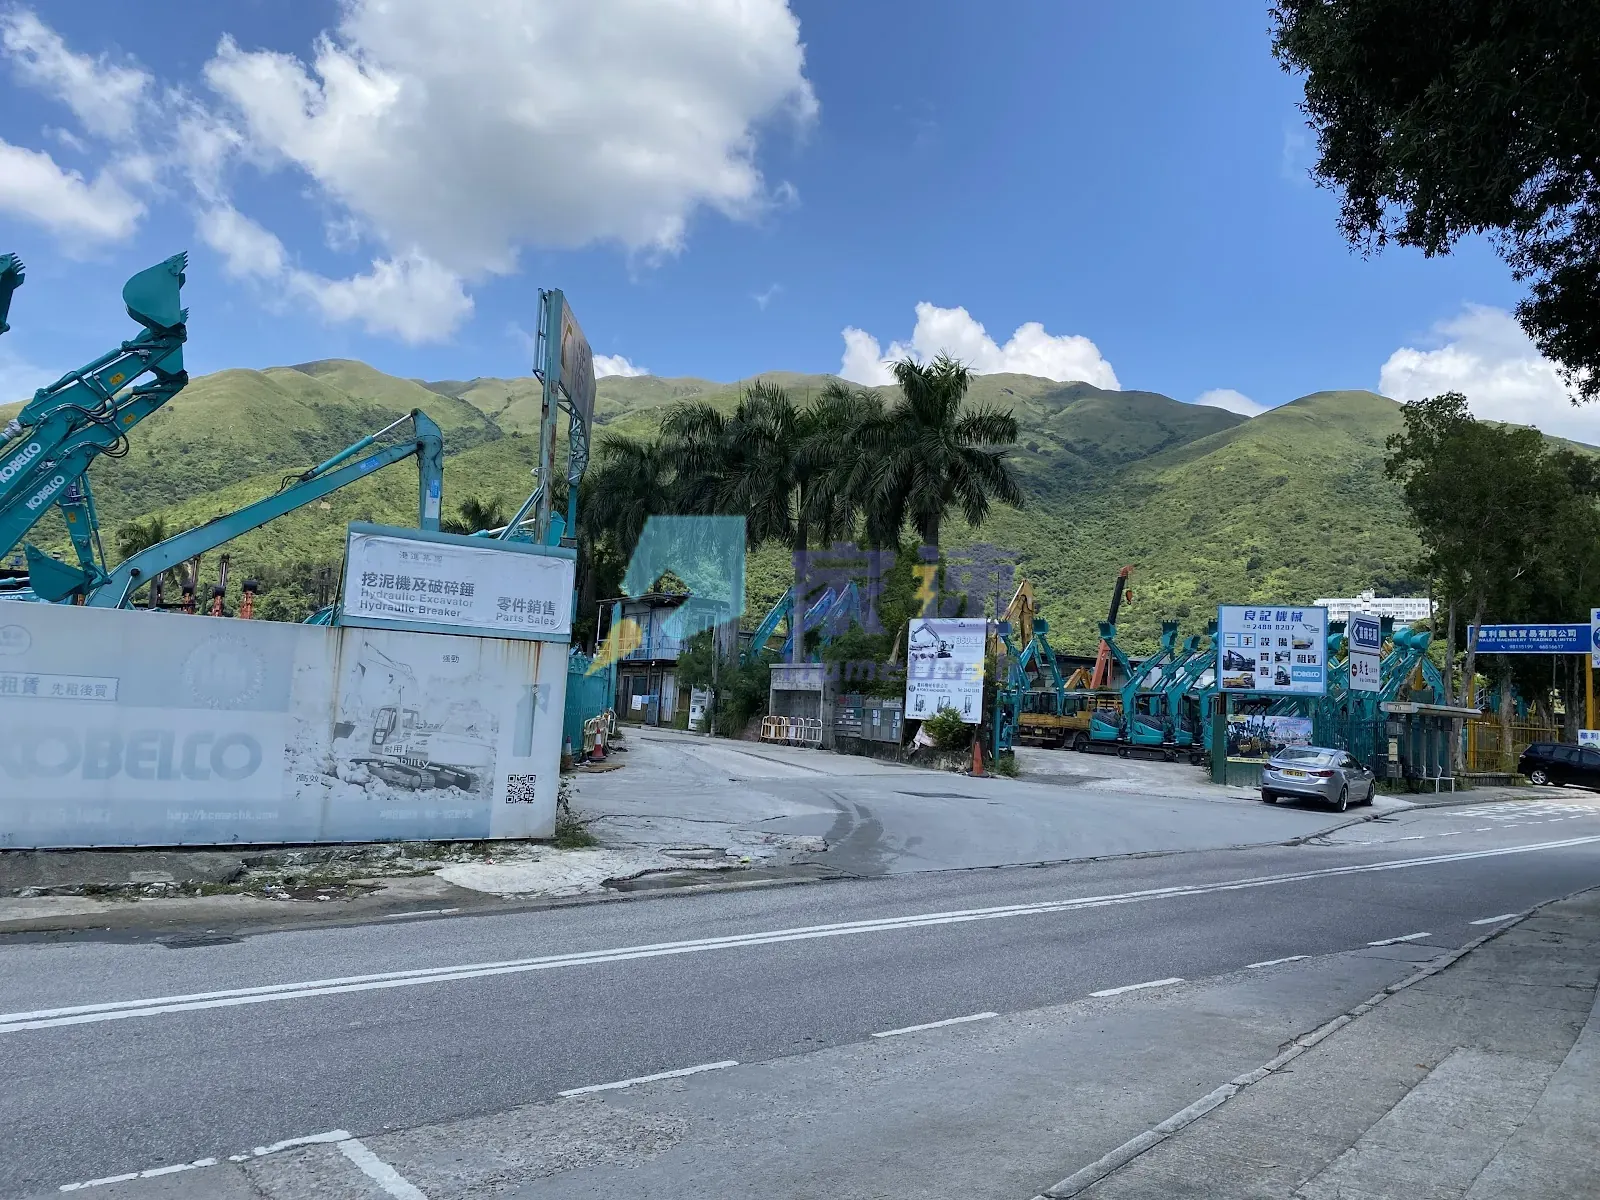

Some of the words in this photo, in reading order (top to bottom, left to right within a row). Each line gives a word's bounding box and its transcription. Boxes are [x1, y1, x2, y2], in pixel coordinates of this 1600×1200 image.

[0, 442, 41, 484] KOBELCO
[26, 475, 65, 510] KOBELCO
[361, 572, 475, 597] 挖泥機及破碎錘
[360, 599, 415, 613] Hydraulic
[418, 605, 461, 617] Breaker
[361, 588, 416, 603] Hydraulic
[419, 594, 474, 608] Excavator
[497, 596, 556, 616] 零件銷售
[496, 612, 525, 624] Parts
[527, 615, 556, 626] Sales
[1244, 610, 1303, 622] 良記機械
